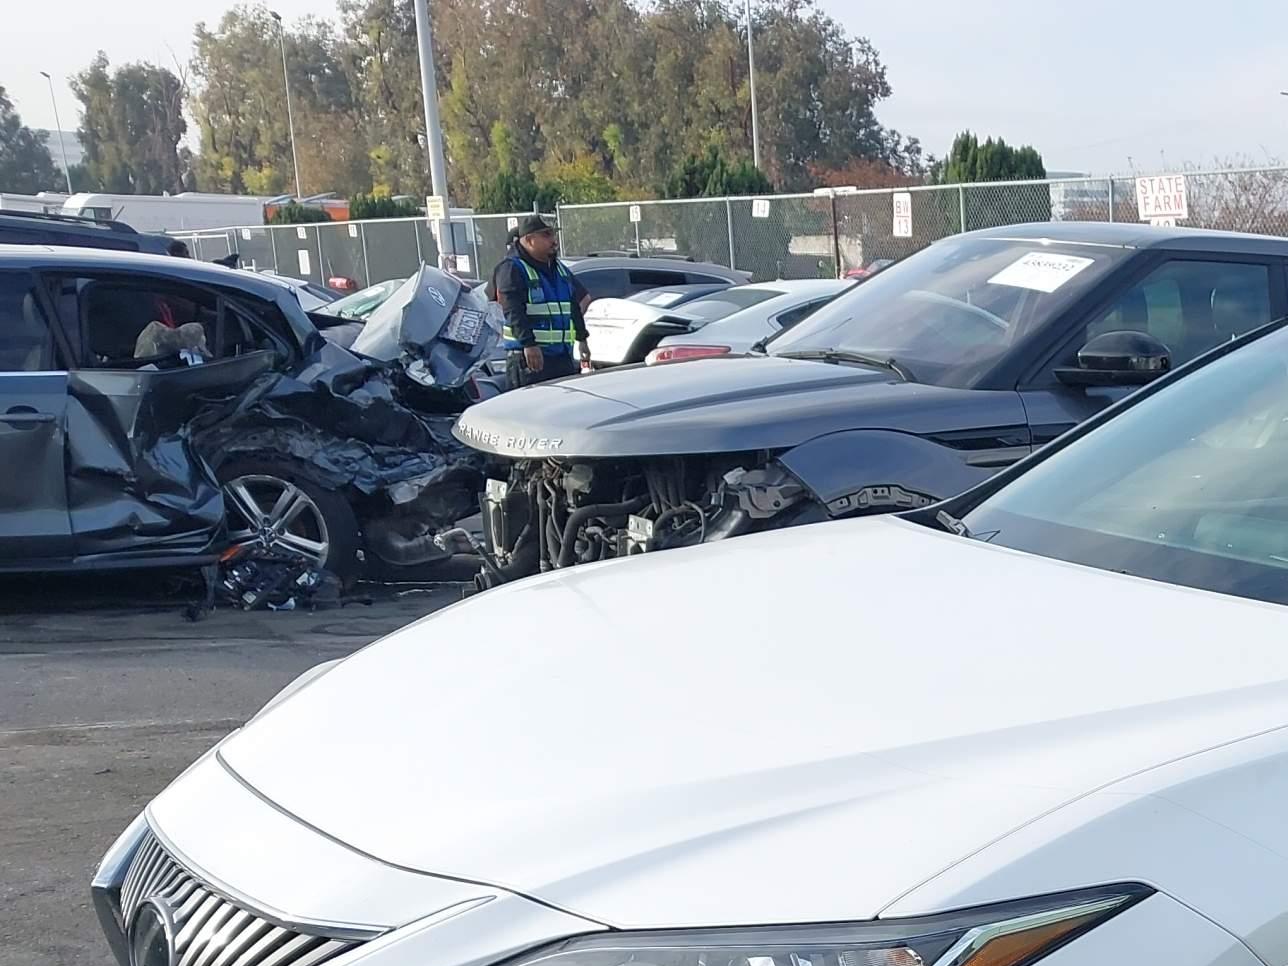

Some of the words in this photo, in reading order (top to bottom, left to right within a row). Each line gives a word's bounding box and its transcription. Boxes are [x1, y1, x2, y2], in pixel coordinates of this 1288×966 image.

[1140, 176, 1183, 194] STATE
[896, 200, 909, 214] BW
[1143, 194, 1183, 212] FARM
[898, 219, 909, 234] 13
[459, 423, 500, 446] RANGE
[507, 437, 563, 449] ROVER
